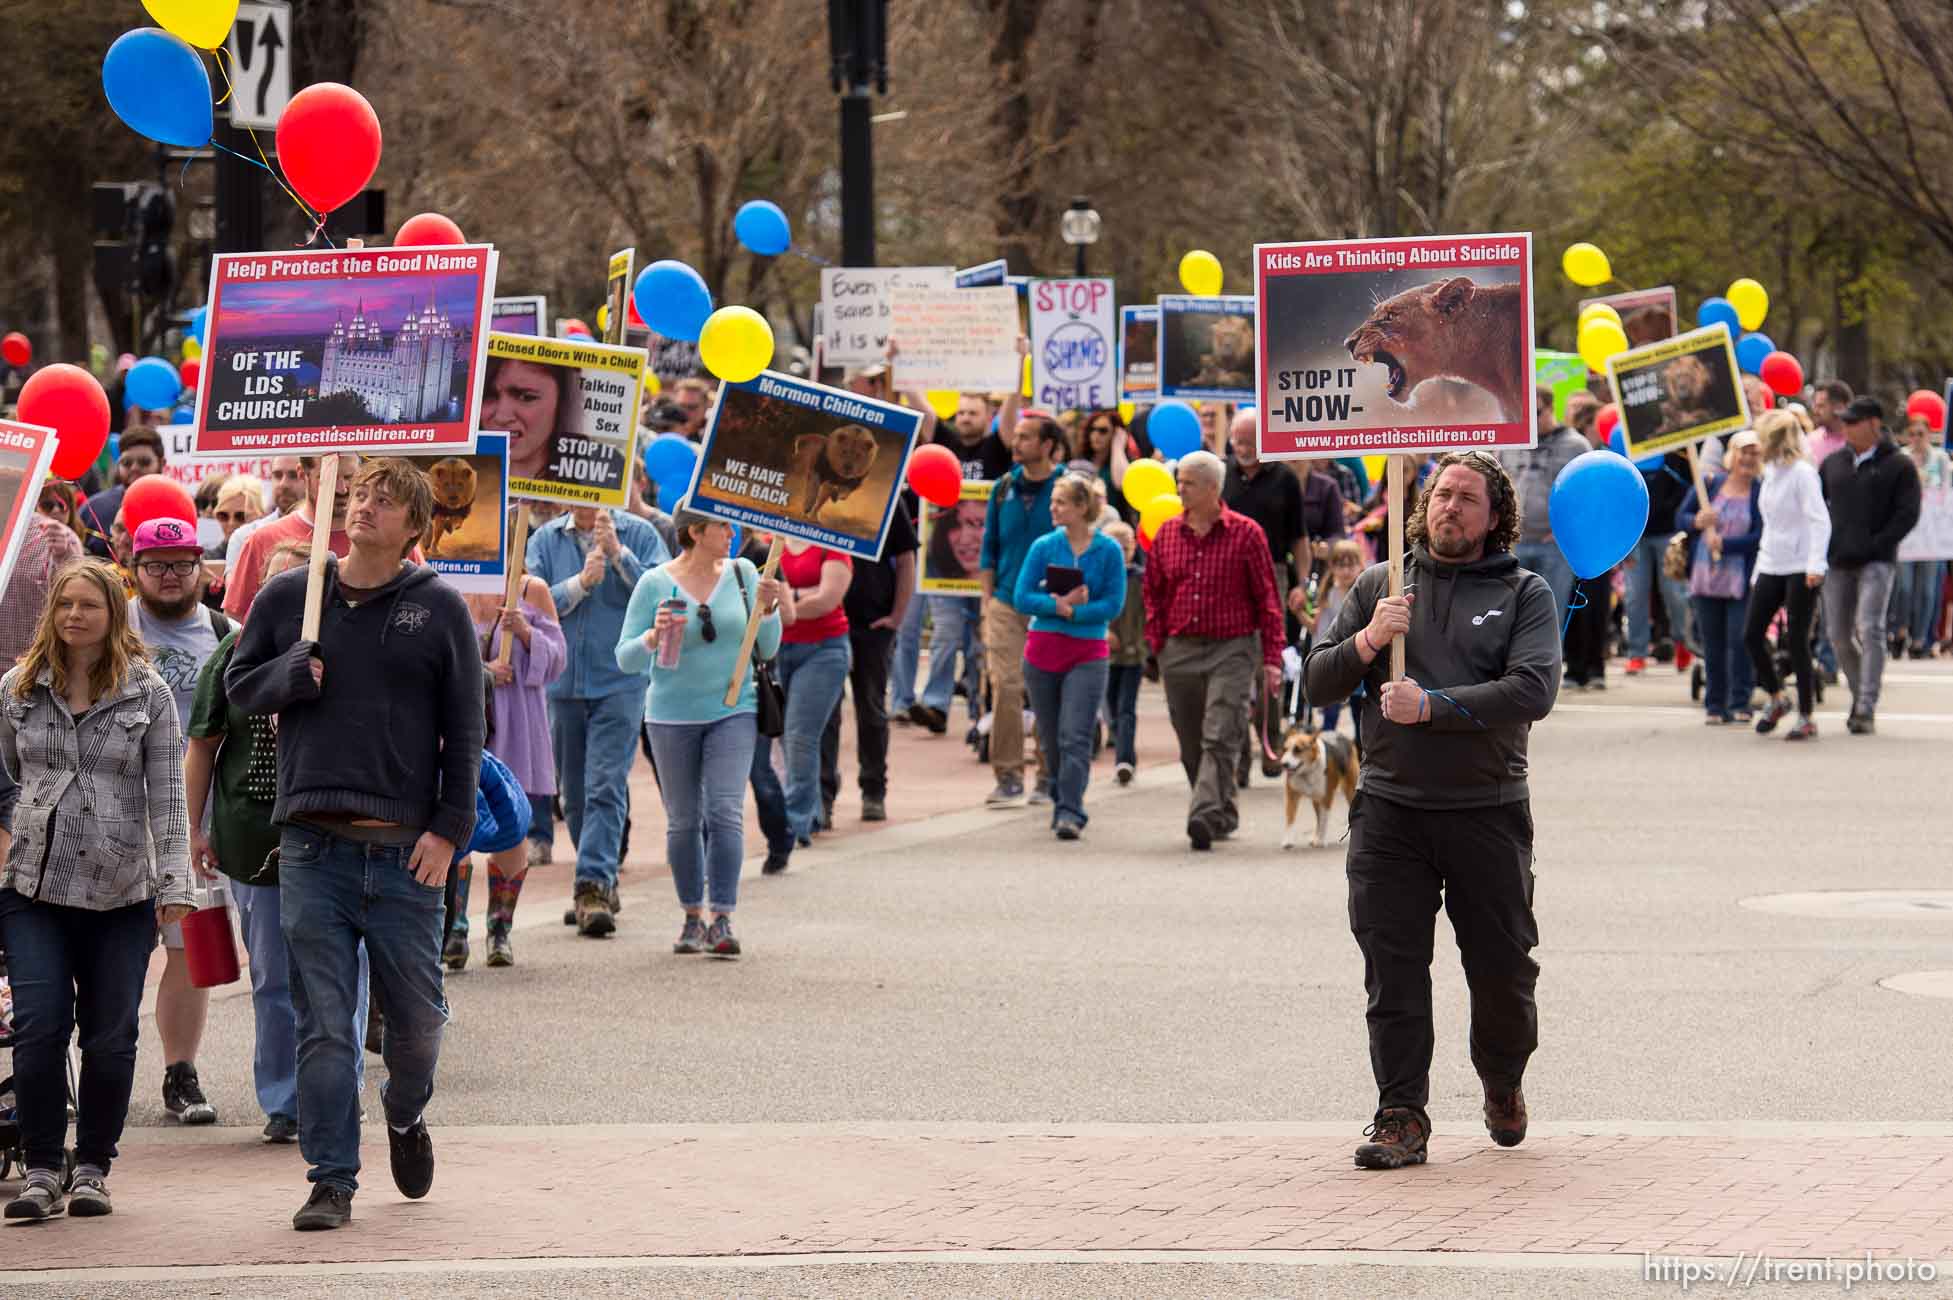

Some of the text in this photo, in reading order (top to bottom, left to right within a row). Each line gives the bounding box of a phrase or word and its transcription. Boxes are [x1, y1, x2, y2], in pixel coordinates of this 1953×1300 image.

[227, 253, 478, 279] Help Protect the Good Name
[1266, 243, 1520, 270] Kids Are Thinking About Suicide
[832, 272, 878, 298] Even
[1037, 281, 1107, 315] STOP
[232, 350, 302, 372] OF THE
[497, 340, 535, 355] Closed
[538, 345, 570, 360] Doors
[573, 349, 598, 364] With
[601, 355, 607, 364] a
[610, 354, 639, 369] Child
[244, 376, 284, 396] LDS
[578, 377, 625, 398] Talking
[1278, 367, 1357, 391] STOP IT
[217, 399, 304, 421] CHURCH
[584, 398, 623, 415] About
[758, 377, 886, 425] Mormon Children
[1271, 394, 1364, 423] -NOW-
[231, 427, 435, 447] www.protectldschildren.org
[595, 418, 620, 433] Sex
[557, 437, 616, 459] STOP IT
[1295, 428, 1496, 449] www.protectldschildren.org
[549, 458, 618, 483] -NOW-
[725, 458, 785, 487] WE HAVE
[711, 473, 790, 507] YOUR BACK
[713, 502, 855, 549] www.protectldschildren.org
